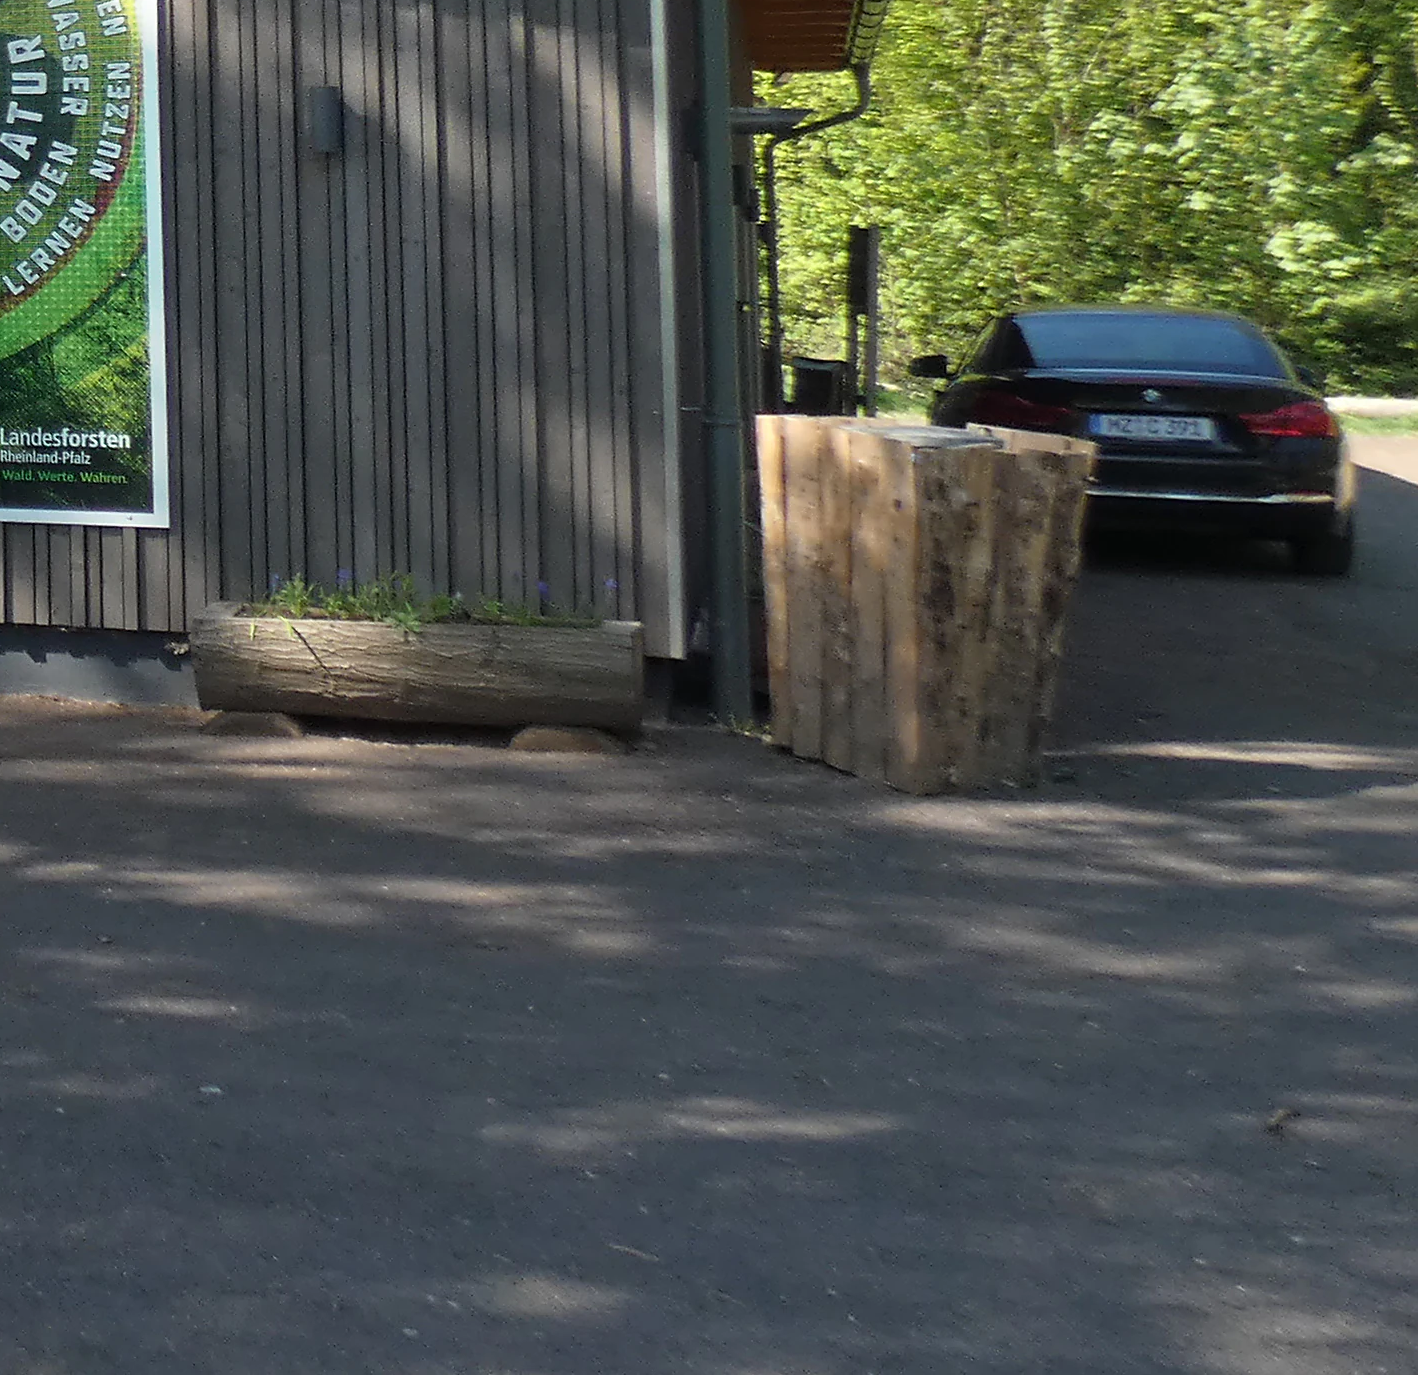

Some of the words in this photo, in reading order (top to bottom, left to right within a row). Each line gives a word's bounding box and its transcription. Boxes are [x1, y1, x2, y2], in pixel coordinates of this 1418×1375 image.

[89, 62, 131, 182] NUTZEN
[0, 140, 79, 244] BODEN
[2, 198, 97, 296] LERNEN
[0, 428, 131, 449] Landesforsten
[0, 450, 91, 465] Rheinland-Pfalz
[3, 470, 35, 482] Wald.
[39, 472, 77, 484] Werte.
[80, 472, 129, 485] Wahren.
